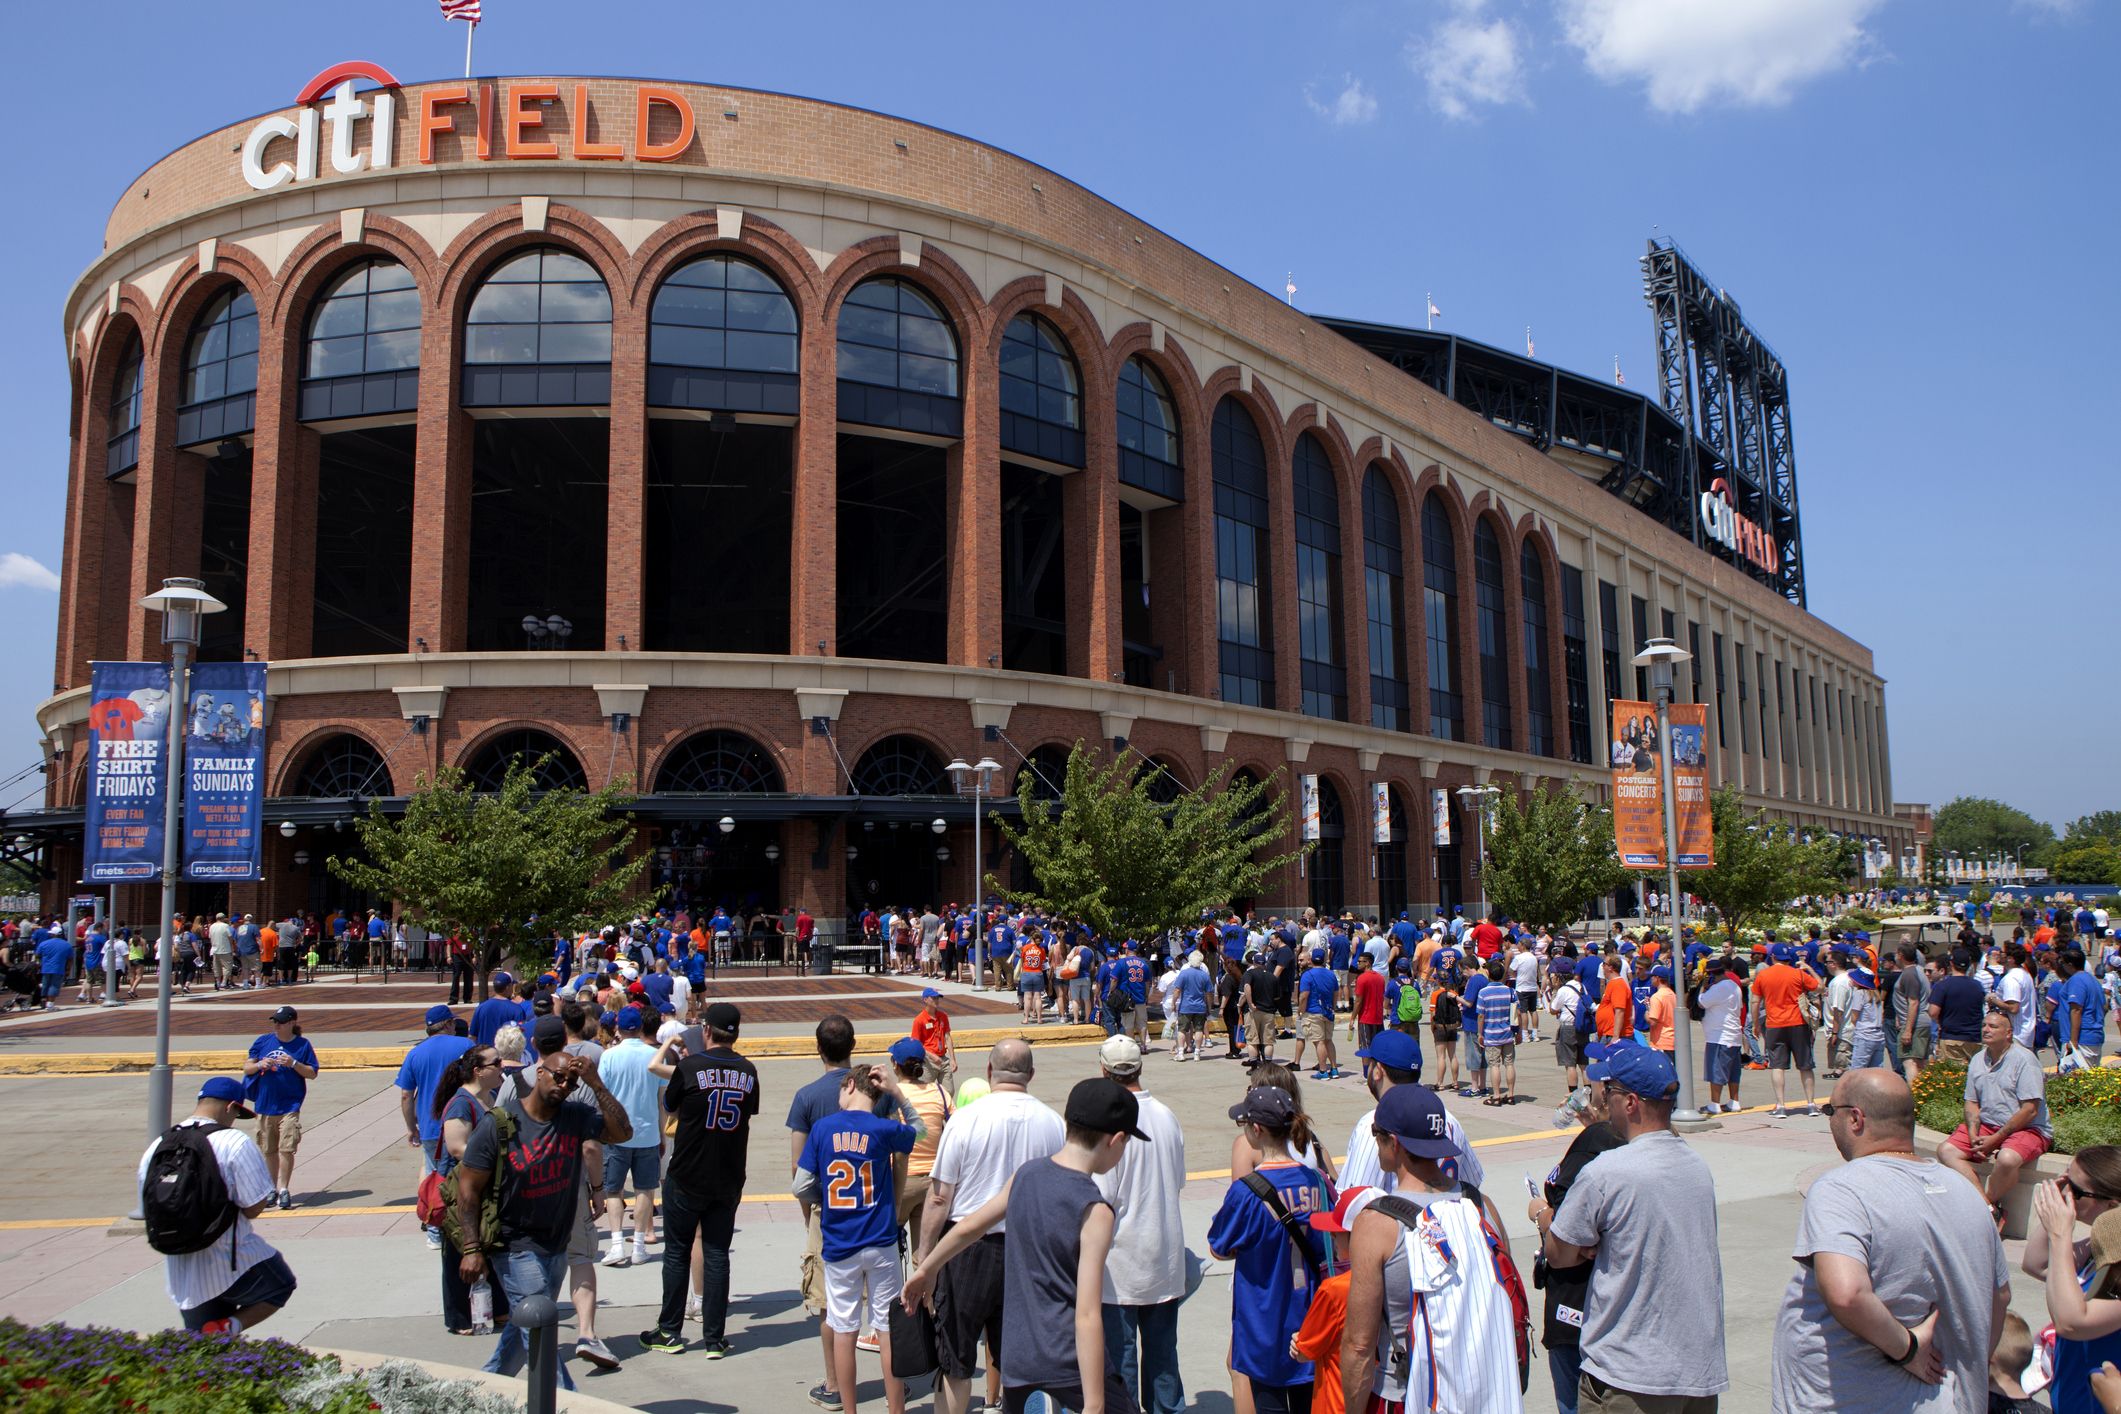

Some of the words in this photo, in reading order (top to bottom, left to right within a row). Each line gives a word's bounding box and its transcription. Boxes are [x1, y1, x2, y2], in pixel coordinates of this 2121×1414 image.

[242, 79, 395, 191] citi
[419, 84, 696, 164] FIELD
[1735, 512, 1778, 575] FIELD
[98, 740, 158, 758] FREE
[97, 760, 156, 775] SHIRT
[193, 758, 256, 771] FAMILY
[96, 776, 156, 797] FRIDAYS
[193, 773, 254, 792] SUNDAYS
[1617, 776, 1657, 785] POSTGAME
[1617, 785, 1657, 799] CONCERTS
[106, 809, 127, 819] EVERY
[129, 809, 145, 819] FAN
[96, 867, 150, 876] mets.com
[1025, 956, 1041, 968] 33
[1441, 957, 1455, 969] 33
[1128, 968, 1144, 983] 33
[696, 1069, 755, 1094] BELTRAN
[705, 1089, 743, 1131] 15
[1427, 1114, 1444, 1136] TB
[833, 1131, 869, 1154] DUDA
[530, 1158, 564, 1185] CLAY
[827, 1159, 874, 1209] 21
[1263, 1186, 1321, 1221] ILSO
